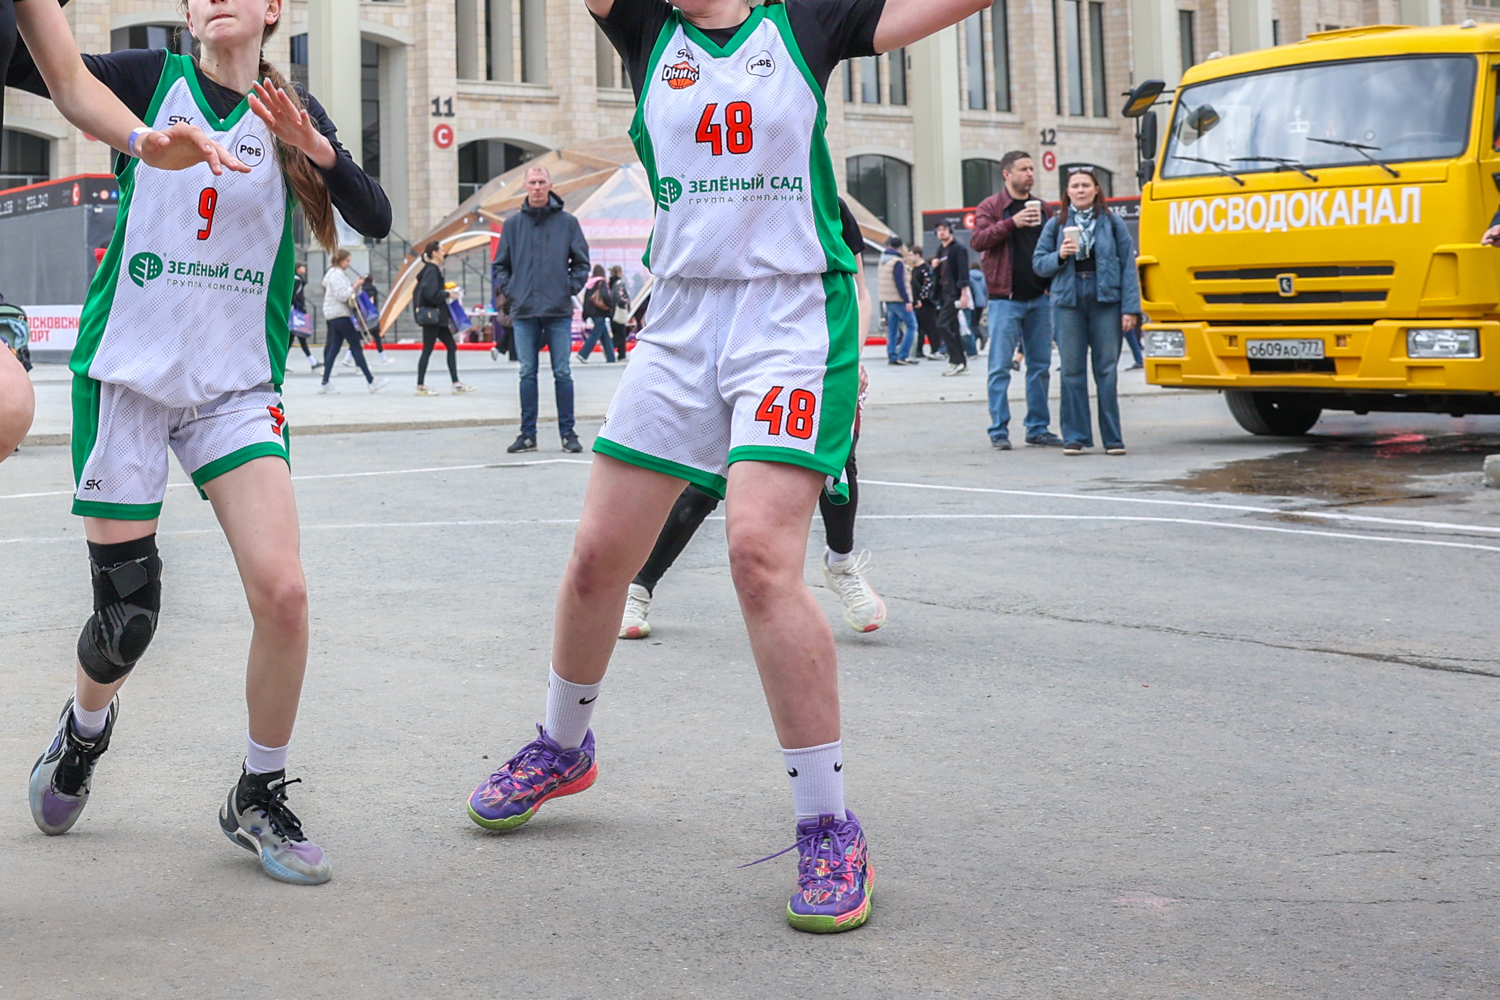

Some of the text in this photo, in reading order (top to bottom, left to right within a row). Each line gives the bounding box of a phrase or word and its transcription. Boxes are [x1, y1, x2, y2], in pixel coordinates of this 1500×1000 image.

[431, 96, 455, 117] 11
[695, 100, 754, 156] 48
[1040, 128, 1057, 146] 12
[239, 144, 262, 157] РФБ
[688, 174, 803, 193] ЗЕЛЁНЫЙ САД
[688, 194, 804, 205] ГРУППА КОМПАНИЙ
[196, 187, 218, 240] 9
[1168, 186, 1421, 235] МОСВОДОКАНАЛ
[167, 260, 265, 286] ЗЕЛЁНЫЙ САД
[166, 278, 263, 296] ГРУППА КОМПАНИЙ
[27, 317, 80, 329] ОСКОВСКИ
[30, 330, 50, 342] ОРТ
[755, 386, 817, 439] 48
